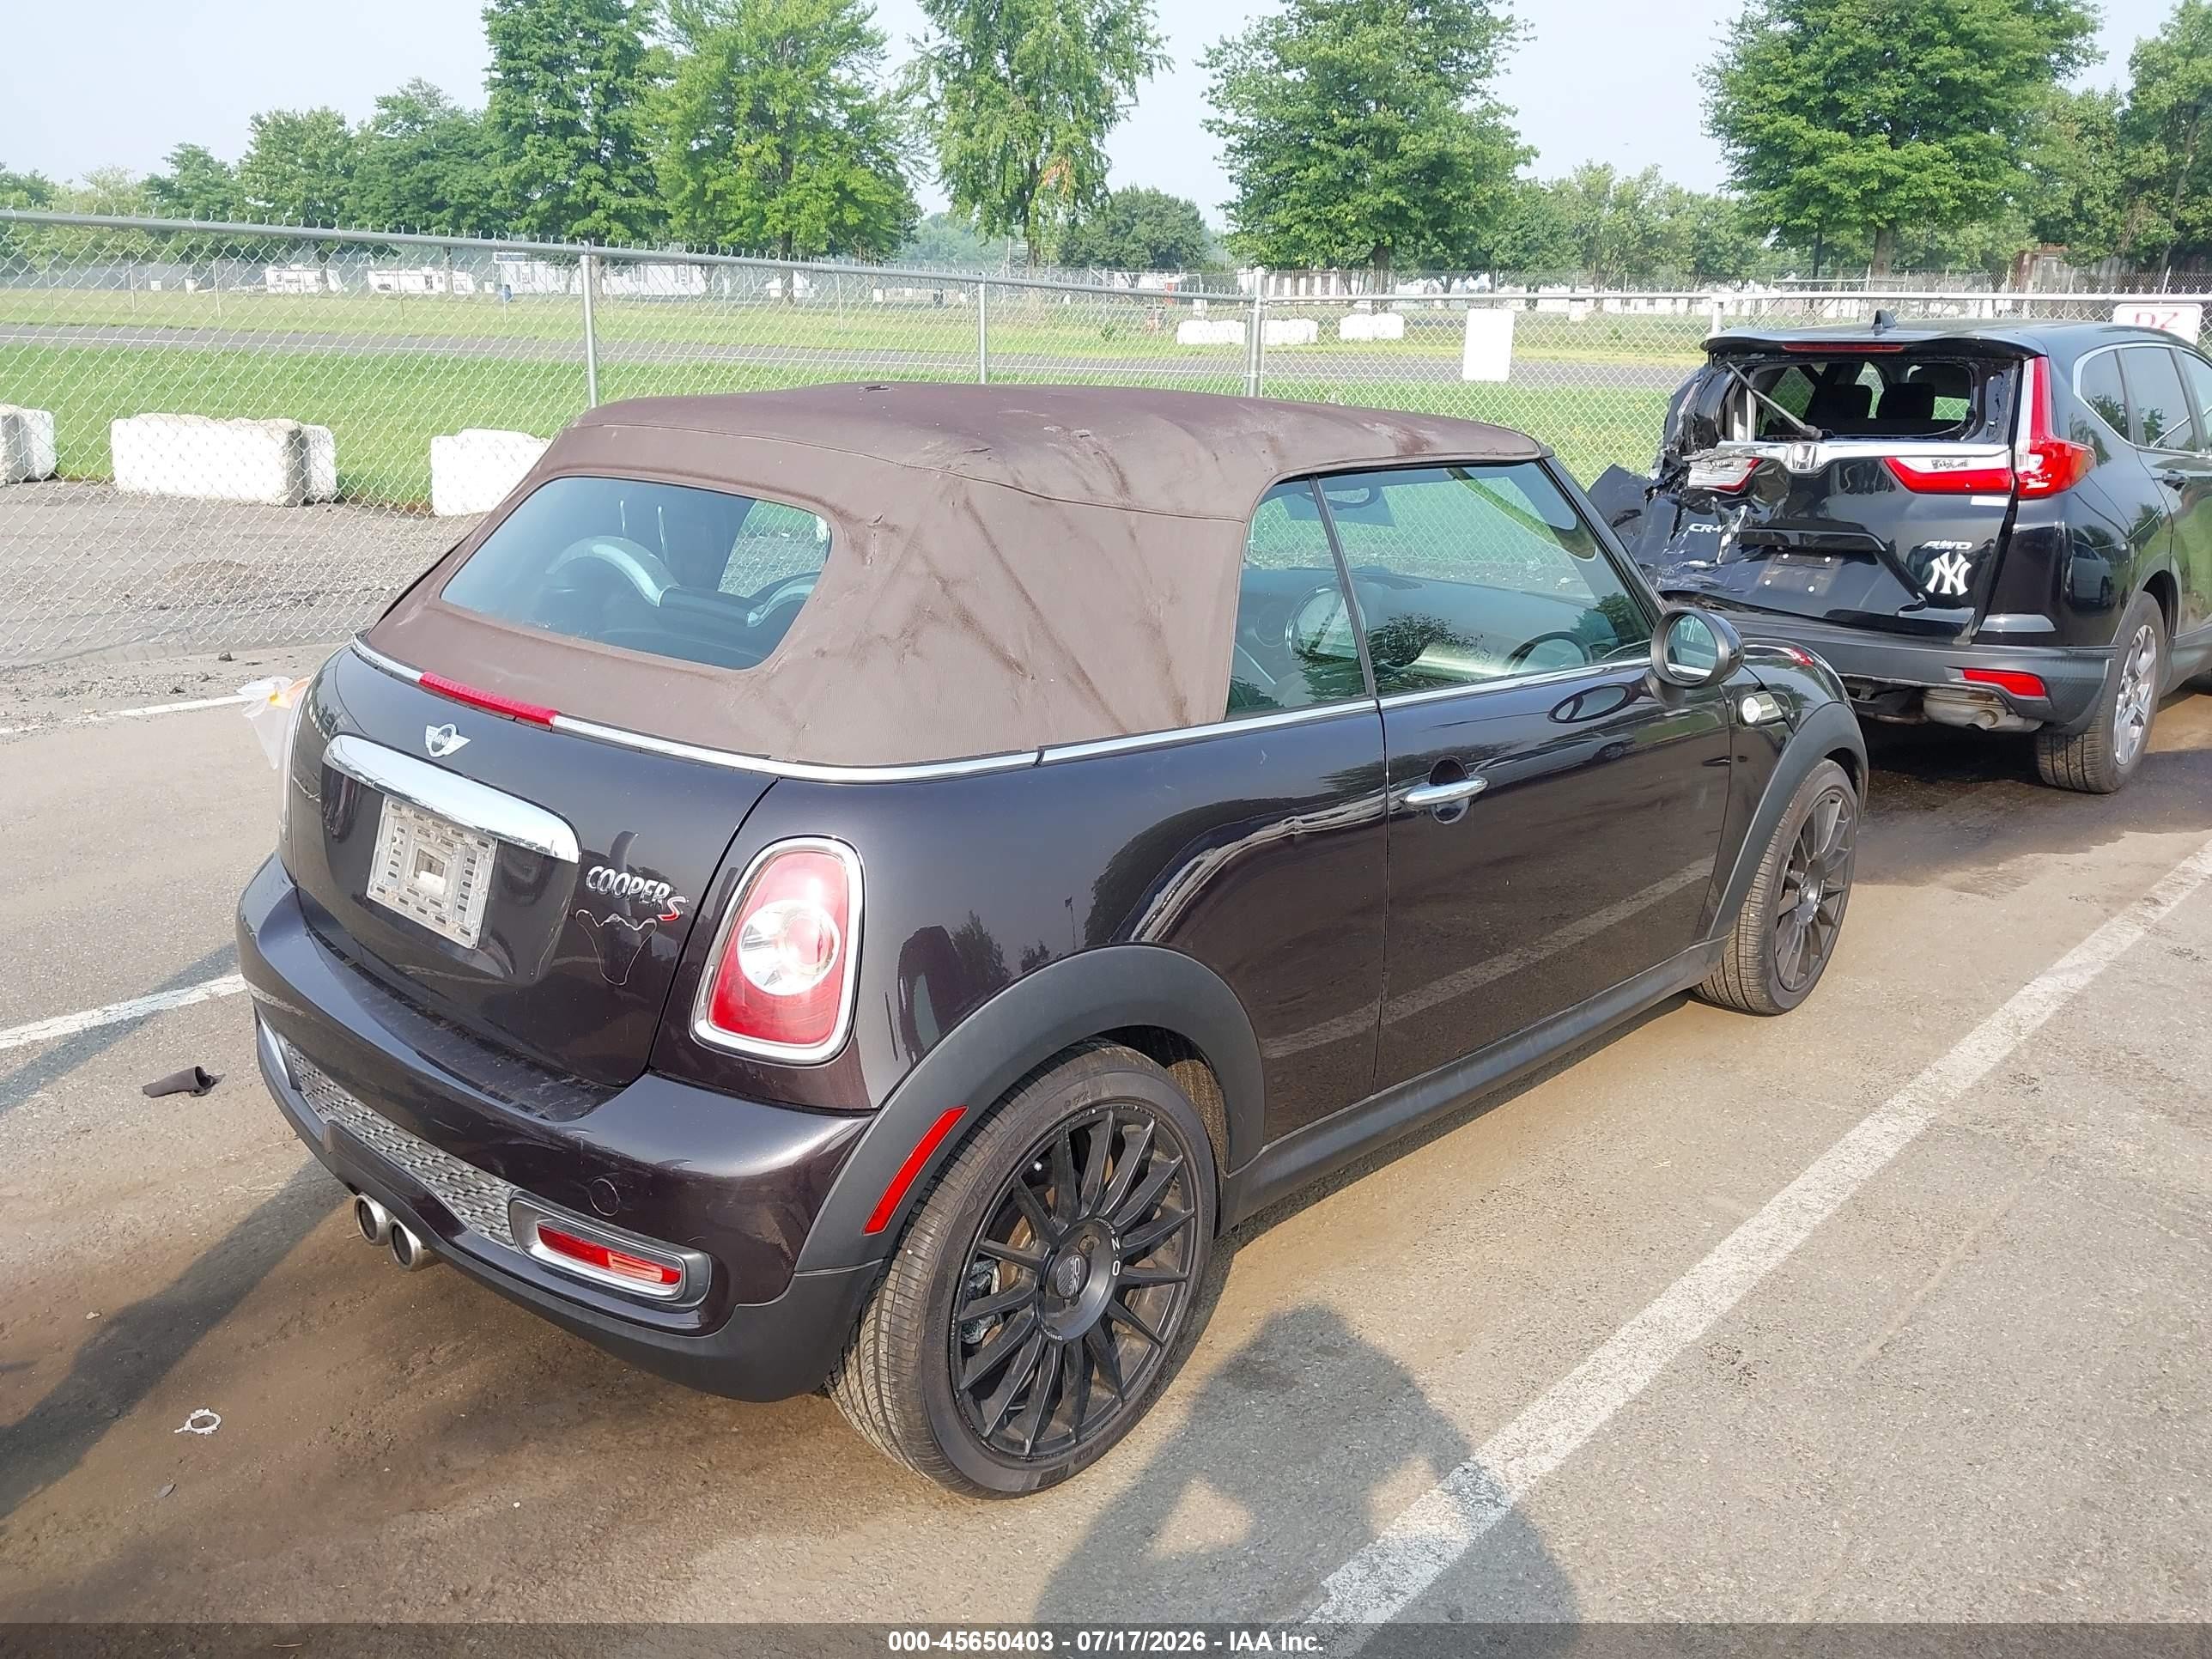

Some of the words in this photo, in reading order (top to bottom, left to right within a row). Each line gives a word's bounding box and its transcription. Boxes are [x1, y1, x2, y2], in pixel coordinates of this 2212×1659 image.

[1921, 541, 1972, 550] AWD
[1926, 551, 1972, 595] NY
[586, 866, 671, 904] COOPER
[656, 896, 689, 921] S
